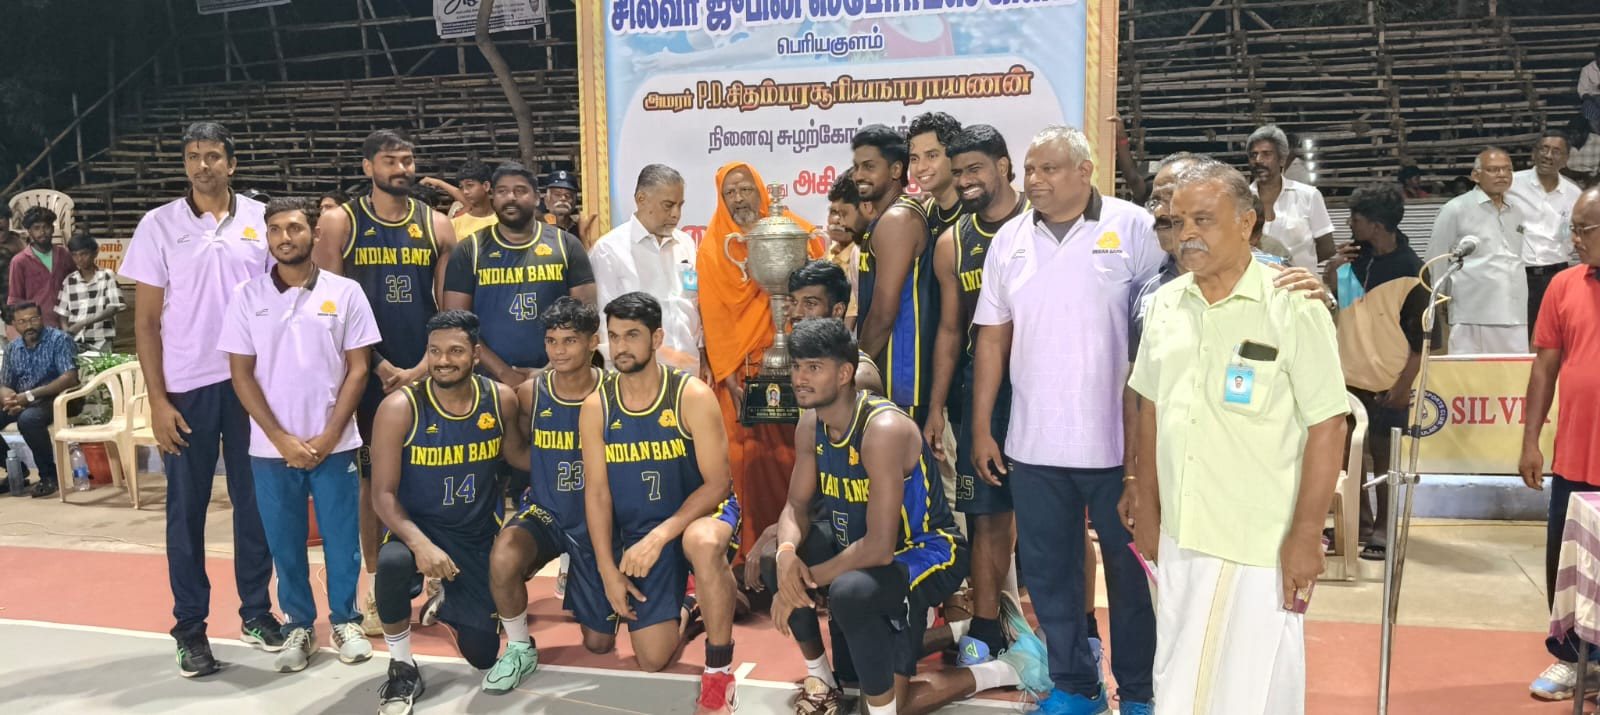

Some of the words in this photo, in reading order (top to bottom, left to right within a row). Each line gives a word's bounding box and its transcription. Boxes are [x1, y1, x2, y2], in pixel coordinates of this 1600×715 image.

[777, 26, 884, 55] பெரியகுளம்
[643, 88, 694, 113] அமரர்
[708, 125, 773, 154] நினைவு
[355, 247, 397, 265] INDIAN
[385, 274, 413, 302] 32
[477, 266, 524, 286] INDIAN
[527, 263, 564, 282] BANK
[508, 292, 538, 320] 45
[410, 445, 464, 466] INDIAN
[442, 473, 476, 506] 14
[557, 460, 585, 491] 23
[641, 470, 661, 501] 7
[832, 510, 850, 547] 5
